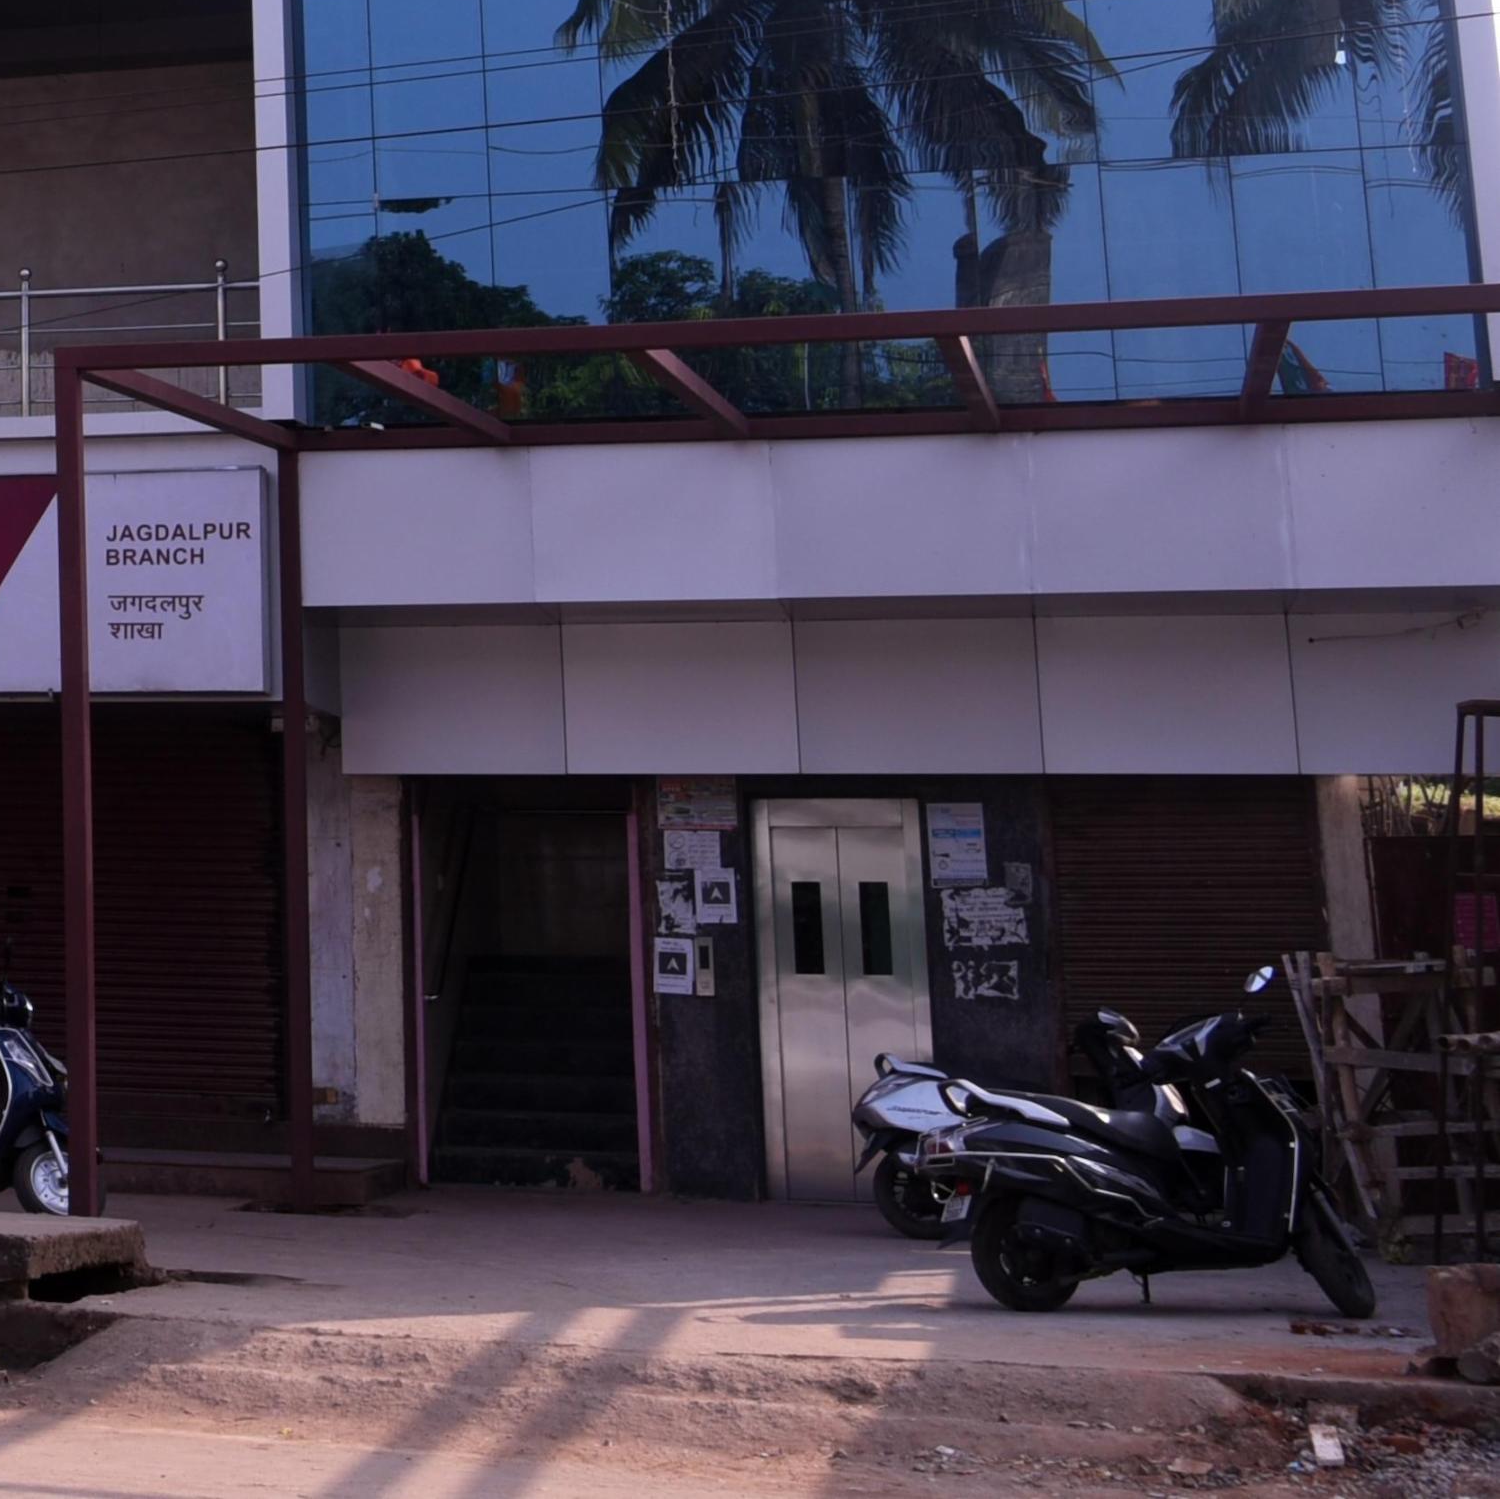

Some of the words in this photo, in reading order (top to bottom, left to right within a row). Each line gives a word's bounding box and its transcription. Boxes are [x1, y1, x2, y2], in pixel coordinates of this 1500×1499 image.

[106, 522, 252, 542] JAGDALPUR
[106, 547, 205, 566] BRANCH
[108, 595, 205, 620] जगदलपुर
[108, 622, 164, 640] शाखा
